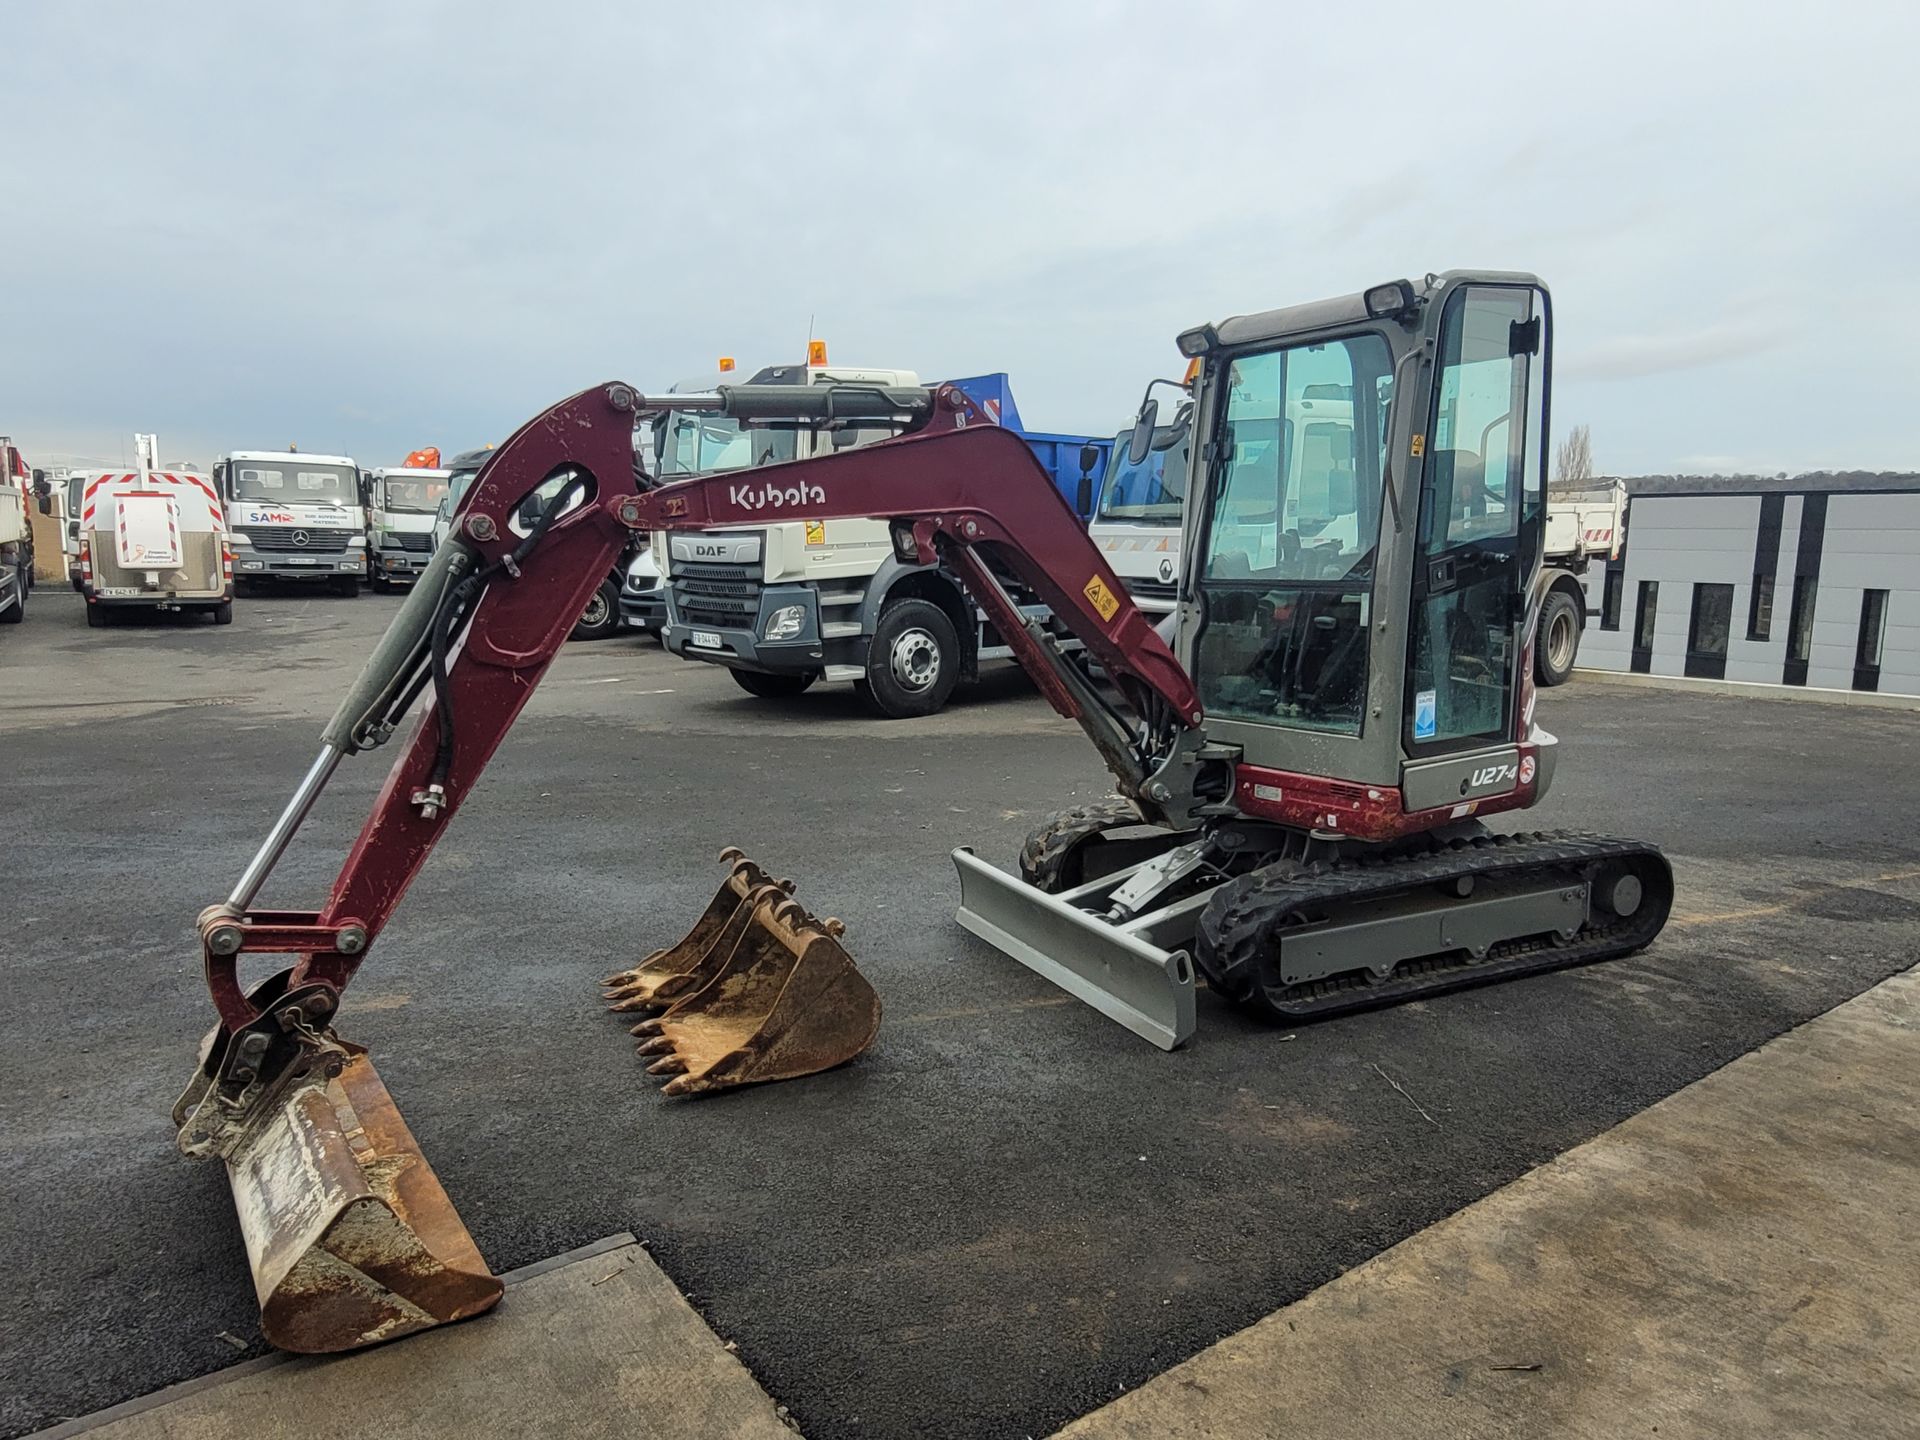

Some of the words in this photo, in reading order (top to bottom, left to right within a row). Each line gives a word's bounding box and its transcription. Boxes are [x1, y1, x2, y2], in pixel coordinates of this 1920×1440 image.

[729, 481, 826, 510] Kubota
[250, 513, 282, 523] SAM
[696, 546, 727, 556] DAF
[1471, 765, 1518, 787] U27-4
